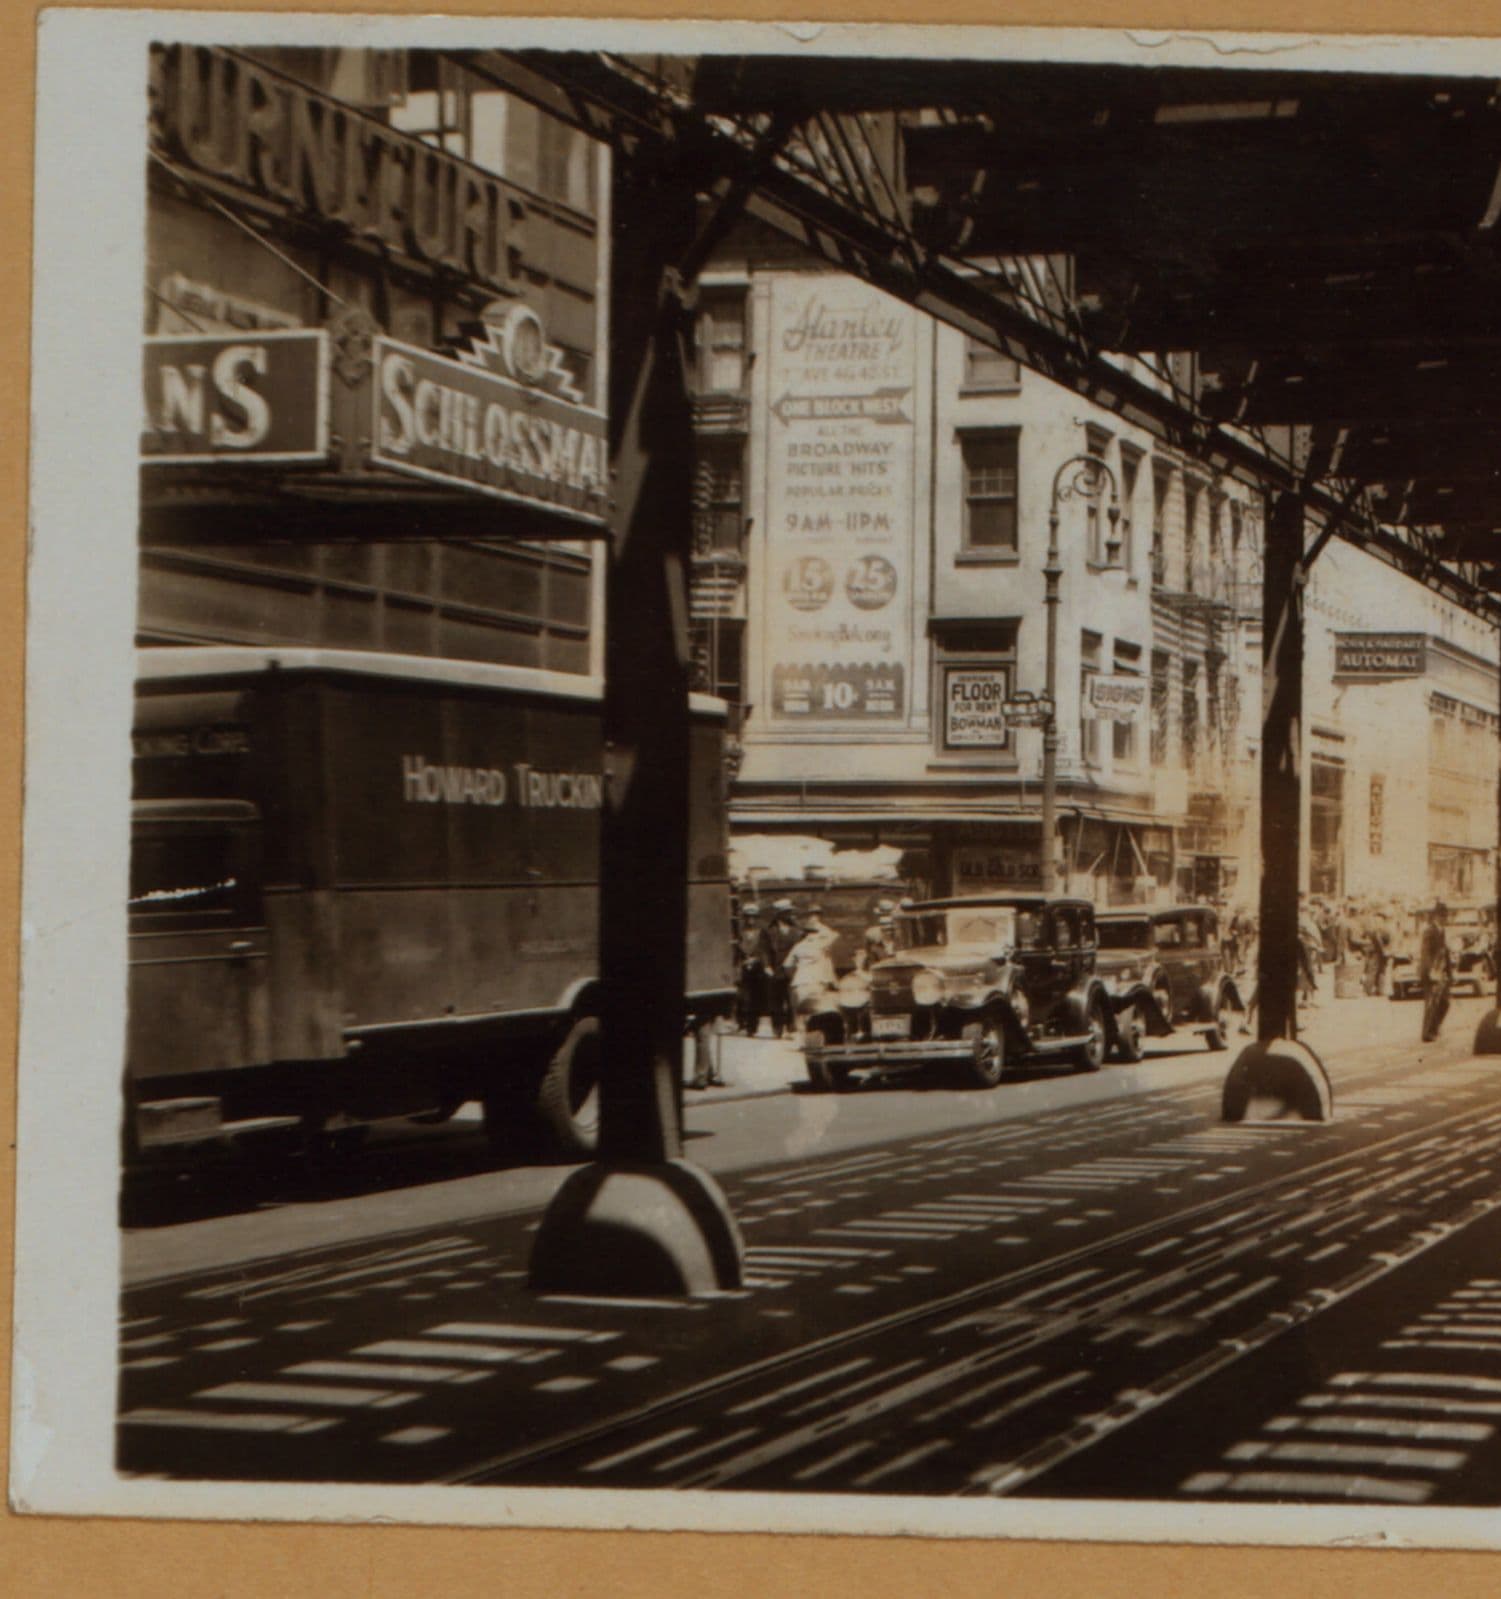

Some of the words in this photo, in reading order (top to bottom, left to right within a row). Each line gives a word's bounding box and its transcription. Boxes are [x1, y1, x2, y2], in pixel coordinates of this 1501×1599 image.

[148, 44, 530, 292] URNITURE
[139, 346, 269, 447] NS
[787, 441, 895, 458] BROADWAY
[786, 461, 842, 476] PICTURE
[1340, 653, 1418, 668] AUTOMAT
[952, 683, 1001, 701] FLOOR
[954, 702, 972, 713] FOR
[951, 716, 1002, 731] BOWMAN
[403, 756, 506, 806] HOWARD
[513, 762, 603, 808] TRUCKIN
